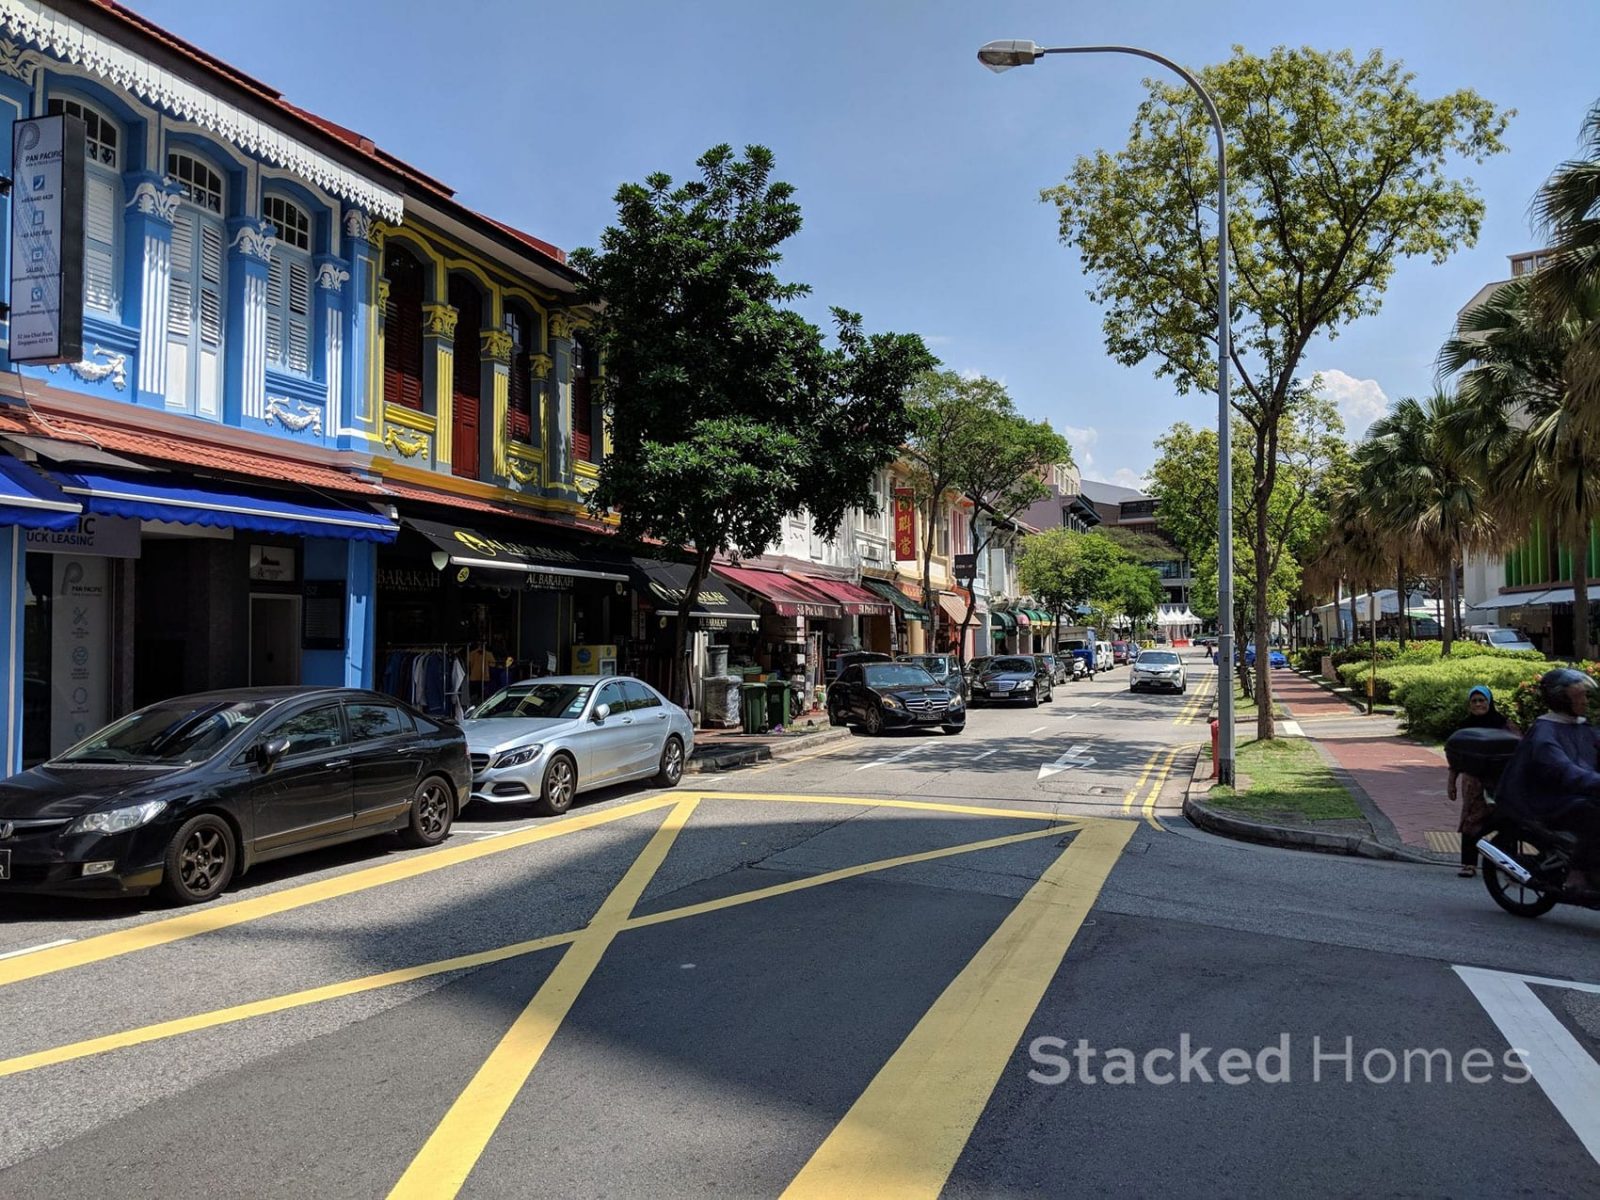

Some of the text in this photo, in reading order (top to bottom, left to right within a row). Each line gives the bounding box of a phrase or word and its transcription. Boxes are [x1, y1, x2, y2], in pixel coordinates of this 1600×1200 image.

[25, 150, 63, 162] PAN PACIFIC
[51, 534, 94, 546] LEASING
[377, 568, 440, 588] BARAKAH
[526, 573, 537, 584] AL
[538, 573, 574, 588] BARAKAH
